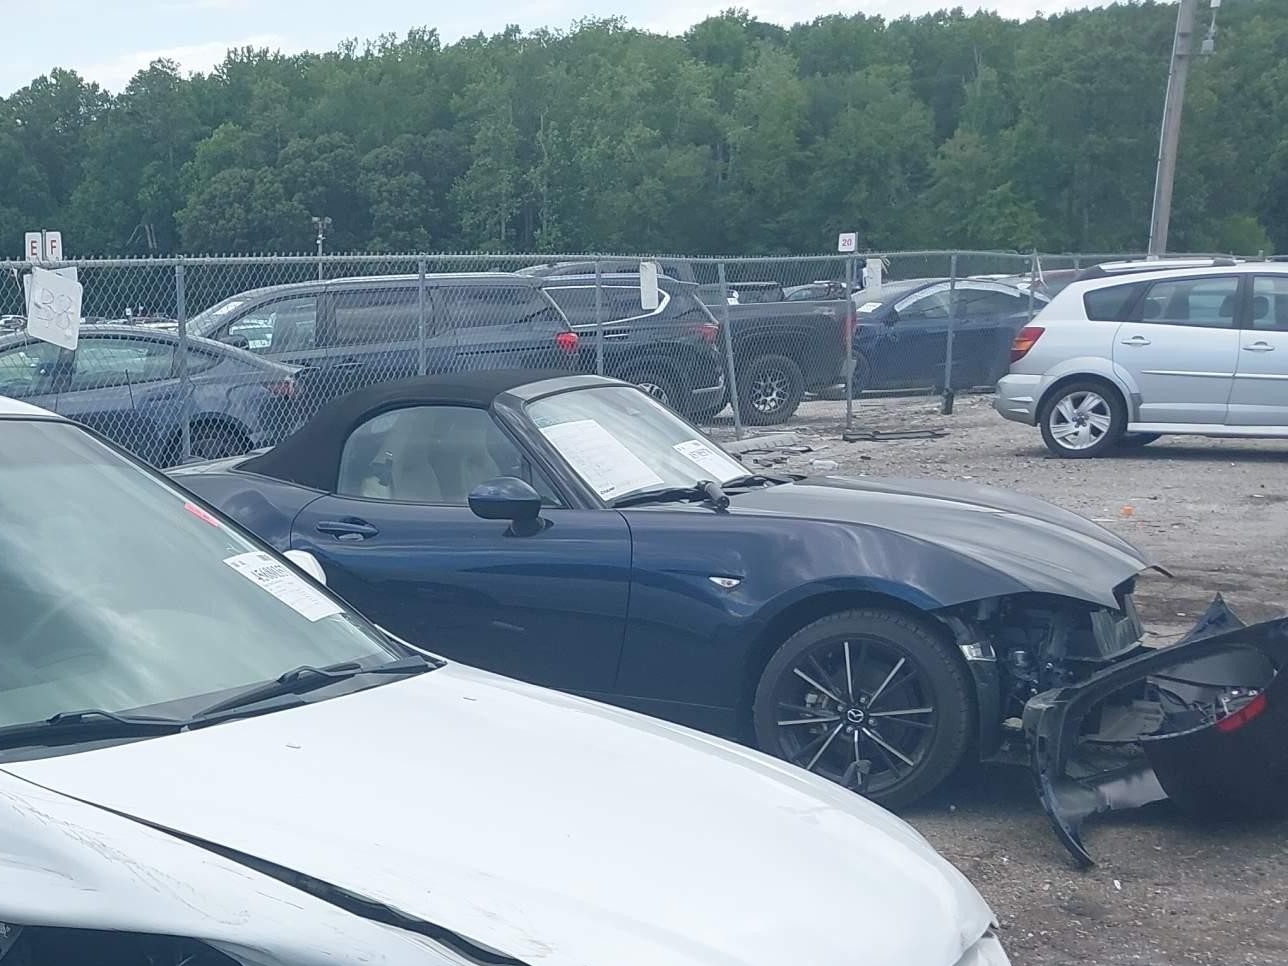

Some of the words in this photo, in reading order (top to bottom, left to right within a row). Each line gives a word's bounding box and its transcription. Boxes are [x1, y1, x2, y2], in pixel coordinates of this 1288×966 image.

[30, 240, 38, 256] E
[50, 239, 57, 256] F
[842, 238, 852, 247] 20
